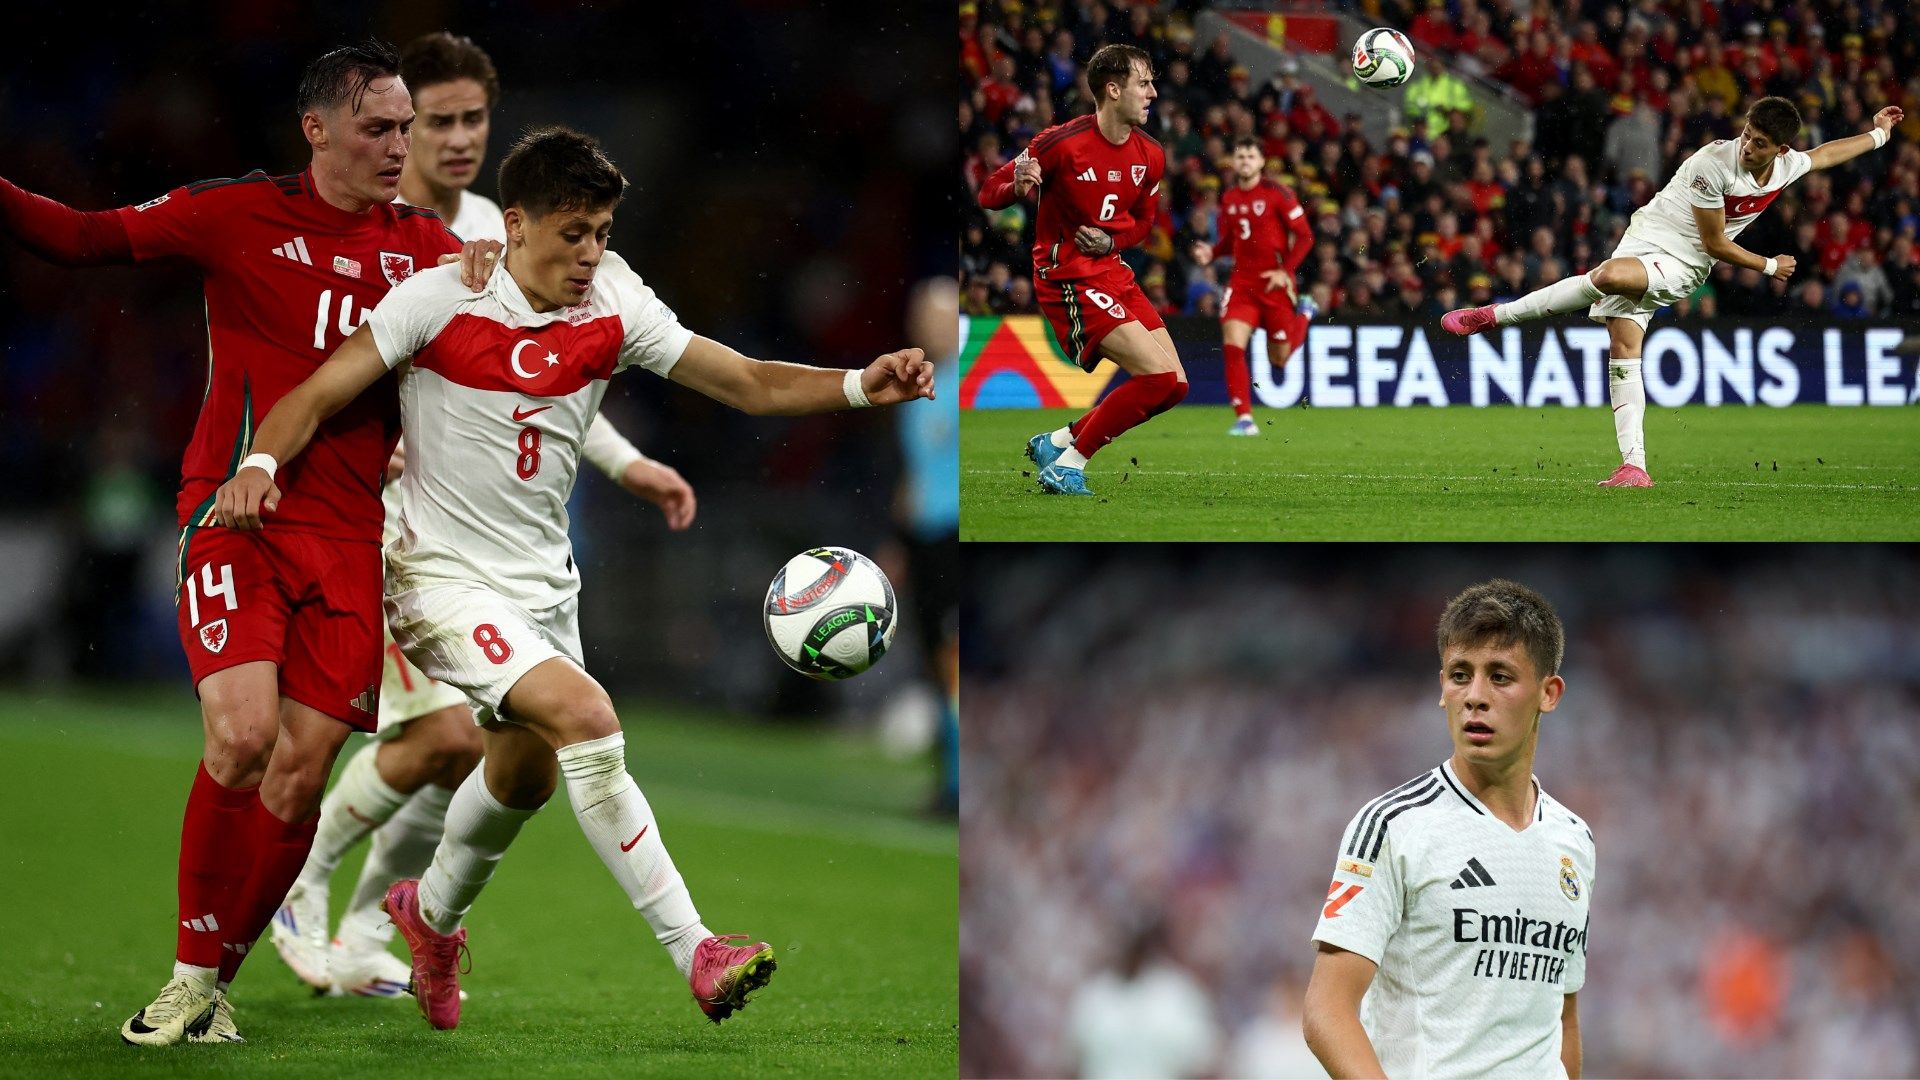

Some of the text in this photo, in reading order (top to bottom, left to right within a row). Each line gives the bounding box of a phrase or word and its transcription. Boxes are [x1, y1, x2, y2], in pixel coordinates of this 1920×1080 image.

[1100, 193, 1119, 222] 6
[1239, 217, 1252, 240] 3
[1085, 288, 1115, 311] 6
[1250, 325, 1450, 408] UEFA
[1467, 326, 1801, 408] NATONS
[516, 425, 543, 482] 8
[186, 561, 239, 628] 14
[814, 609, 858, 642] LEAGUE
[472, 623, 514, 665] 8
[1473, 949, 1510, 978] FLY
